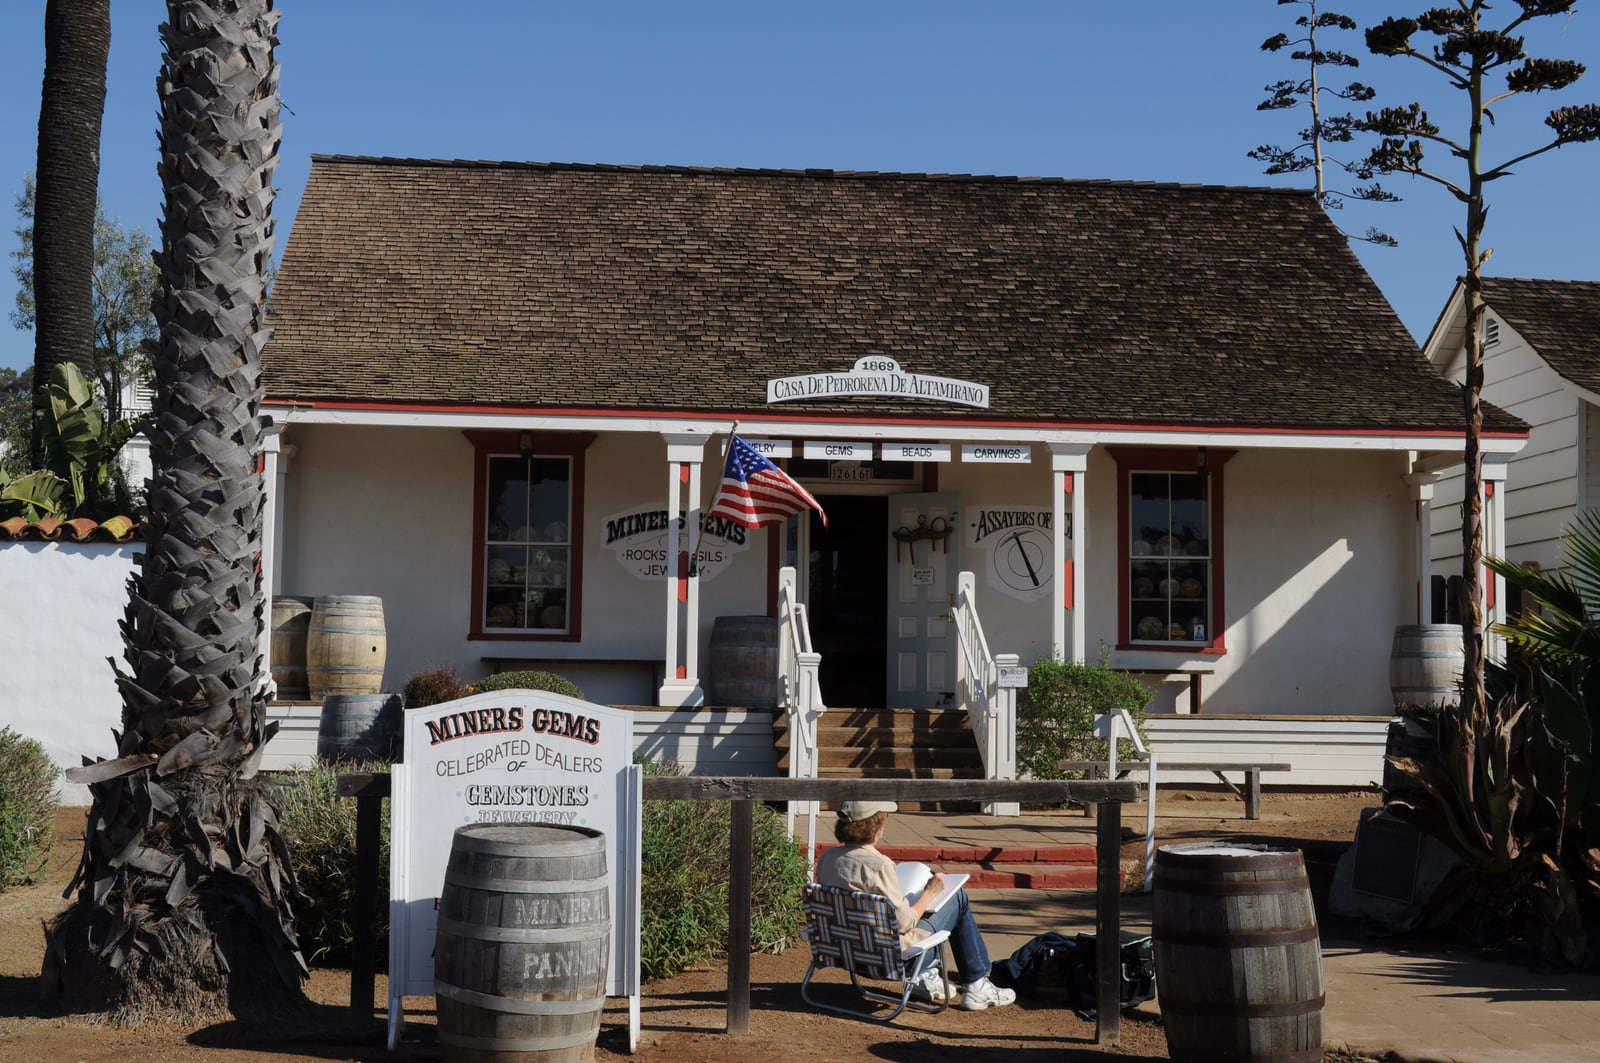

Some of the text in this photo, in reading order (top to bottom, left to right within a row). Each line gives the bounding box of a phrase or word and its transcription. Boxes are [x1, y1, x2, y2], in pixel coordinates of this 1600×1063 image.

[862, 361, 895, 371] 1869
[825, 445, 853, 456] GEMS
[902, 447, 932, 457] BEADS
[974, 448, 1021, 460] CARVINGS
[837, 469, 865, 479] 2616
[975, 511, 1035, 543] ASSAYERS
[626, 550, 667, 561] ROCKS
[425, 707, 600, 746] MINERS GEMS
[436, 740, 603, 776] CELEBRATED DEALERS
[507, 760, 527, 772] OF
[465, 784, 589, 807] GEMSTONES
